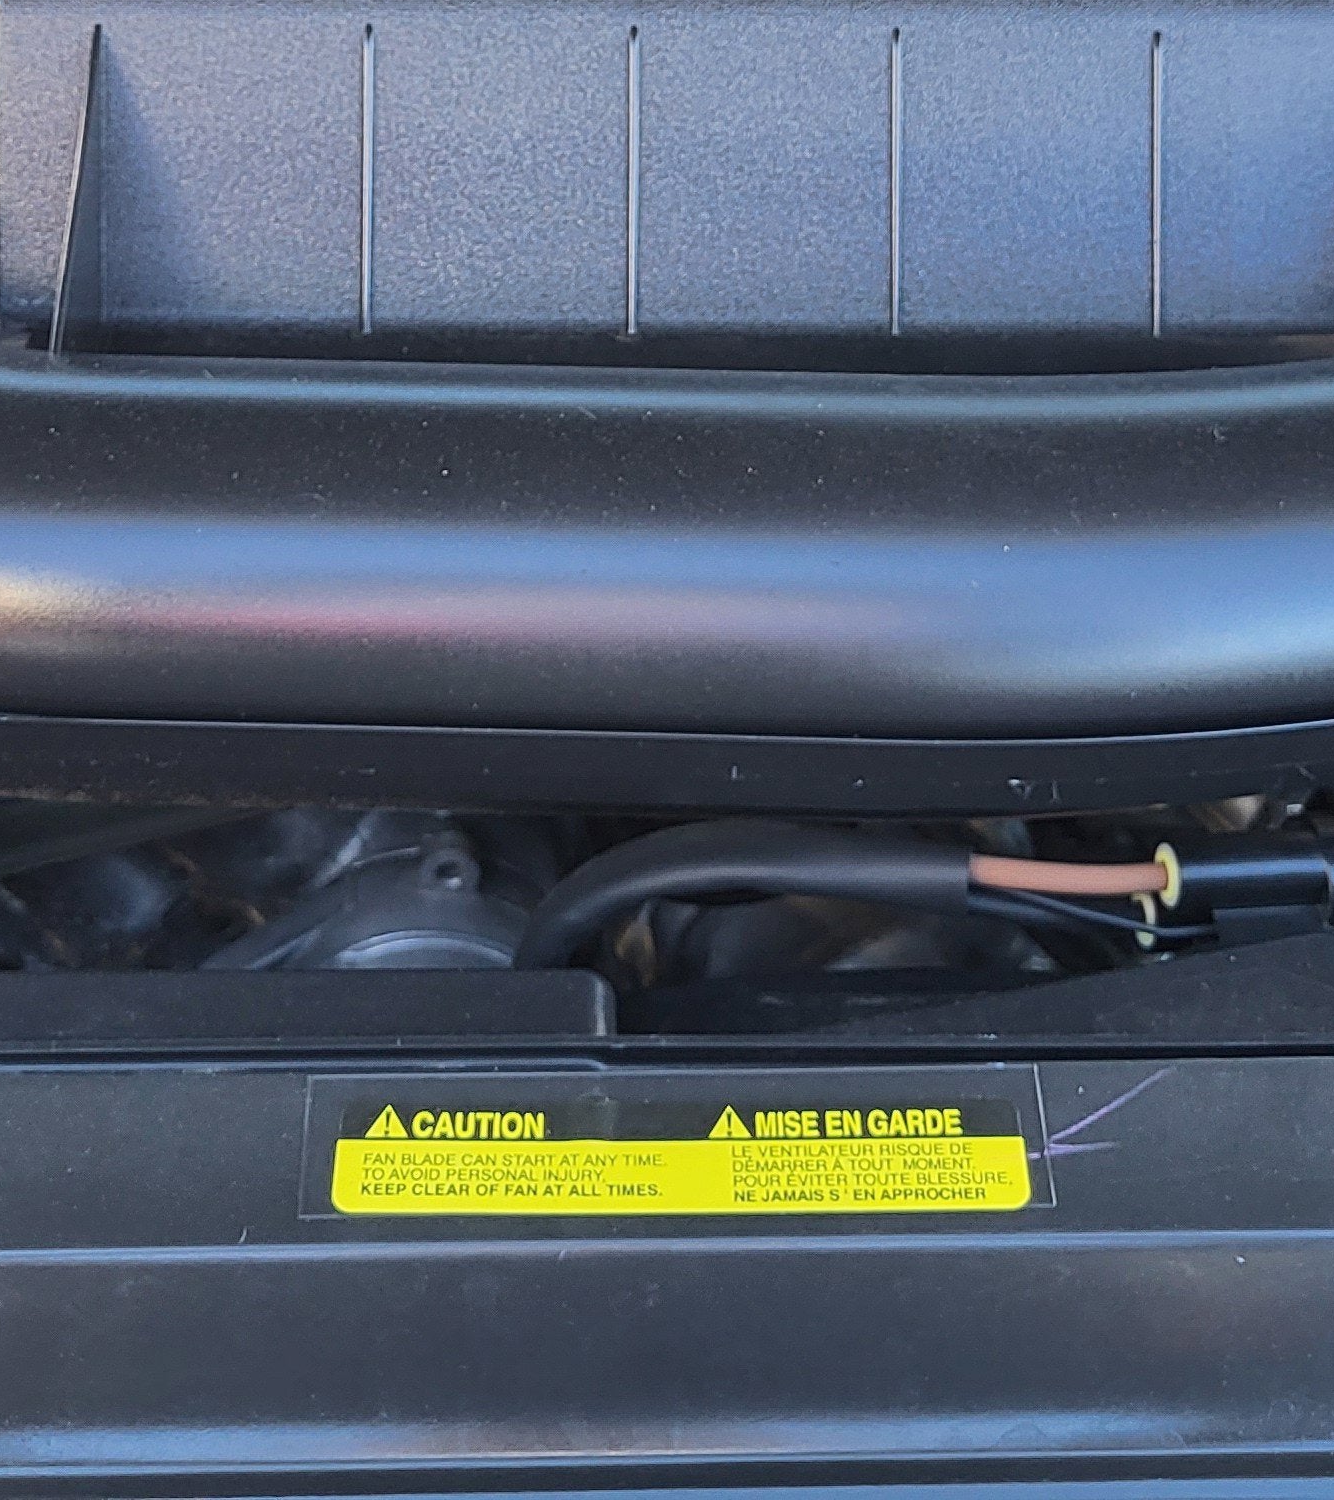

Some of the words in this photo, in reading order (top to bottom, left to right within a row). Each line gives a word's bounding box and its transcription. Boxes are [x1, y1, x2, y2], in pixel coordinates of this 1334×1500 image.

[411, 1111, 546, 1140] CAUTION
[754, 1110, 820, 1138] MISE
[824, 1109, 862, 1138] EN
[866, 1108, 964, 1137] GARDE
[731, 1145, 754, 1158] LE
[757, 1144, 874, 1158] VENTILATEUR
[881, 1142, 945, 1157] RISQUE
[949, 1142, 973, 1155] DE
[363, 1153, 396, 1166] FAN
[401, 1153, 457, 1166] BLADE
[460, 1154, 498, 1167] CAN
[501, 1154, 555, 1167] START
[559, 1154, 583, 1167] AT
[583, 1154, 618, 1167] ANY
[620, 1154, 667, 1168] TIME.
[732, 1155, 828, 1173] DÉMARRER
[849, 1157, 892, 1171] TOUT
[363, 1167, 390, 1182] TO
[391, 1168, 441, 1182] AVOID
[446, 1168, 536, 1182] PERSONAL
[732, 1174, 781, 1187] POUR
[786, 1170, 848, 1187] ÉVITER
[854, 1173, 912, 1186] TOUTE
[916, 1171, 1014, 1186] BLESSURE,
[360, 1182, 406, 1196] KEEP
[411, 1183, 469, 1197] CLEAR
[474, 1183, 499, 1197] OF
[503, 1183, 538, 1197] FAN
[541, 1183, 565, 1197] AT
[568, 1183, 601, 1197] ALL
[607, 1183, 663, 1197] TIMES.
[734, 1189, 757, 1202] NE
[760, 1189, 825, 1202] JAMAIS
[880, 1186, 987, 1201] APPROCHER
